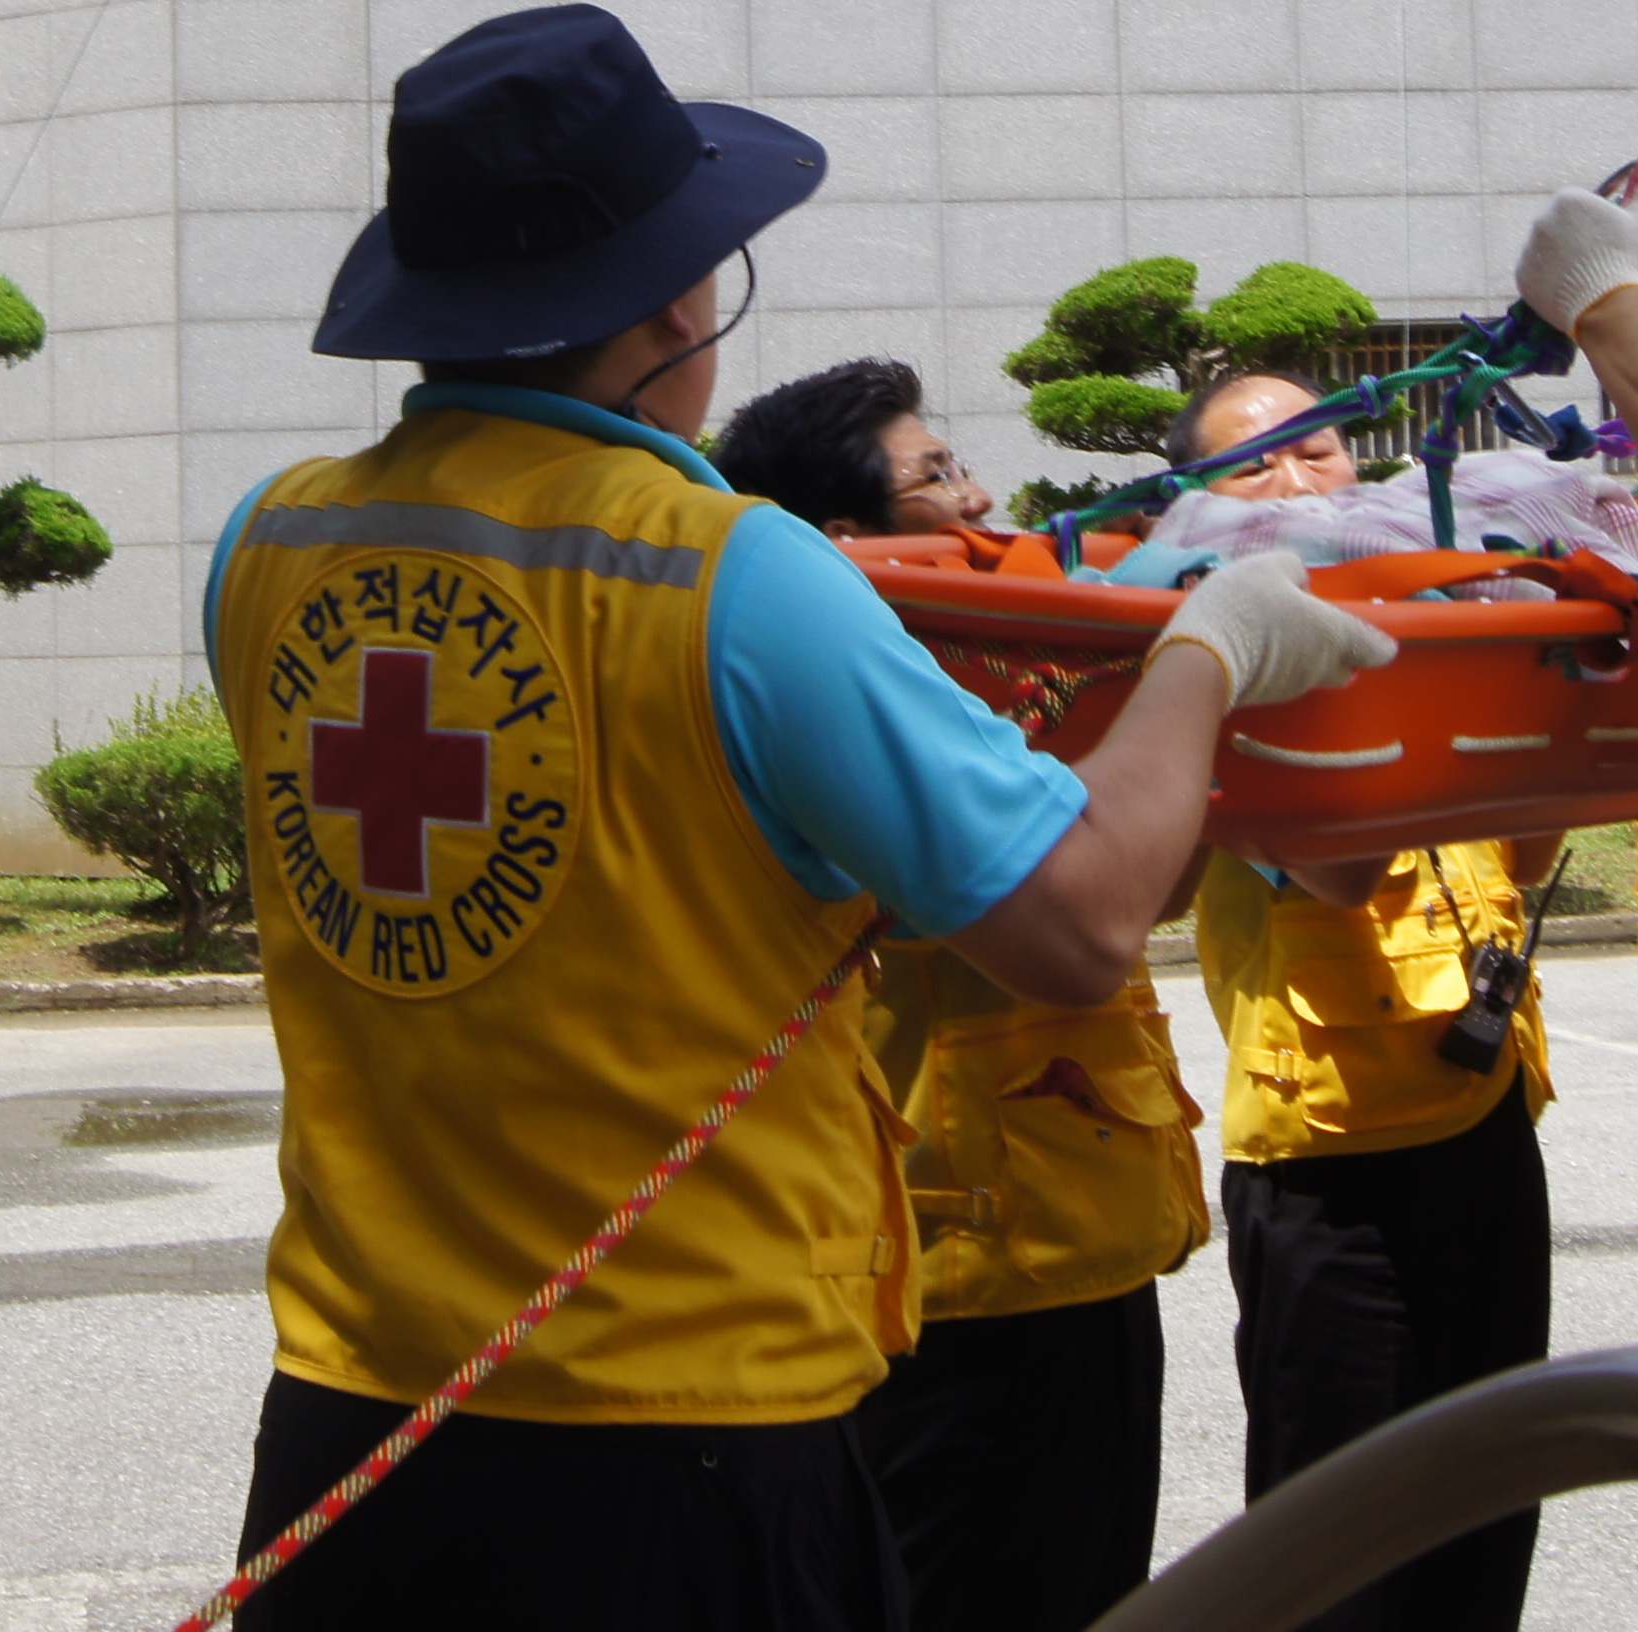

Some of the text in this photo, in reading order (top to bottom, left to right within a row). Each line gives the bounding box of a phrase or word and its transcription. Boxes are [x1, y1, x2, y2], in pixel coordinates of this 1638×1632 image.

[268, 563, 558, 731] 대한적십자사
[265, 771, 567, 983] KOREAN RED CROSS
